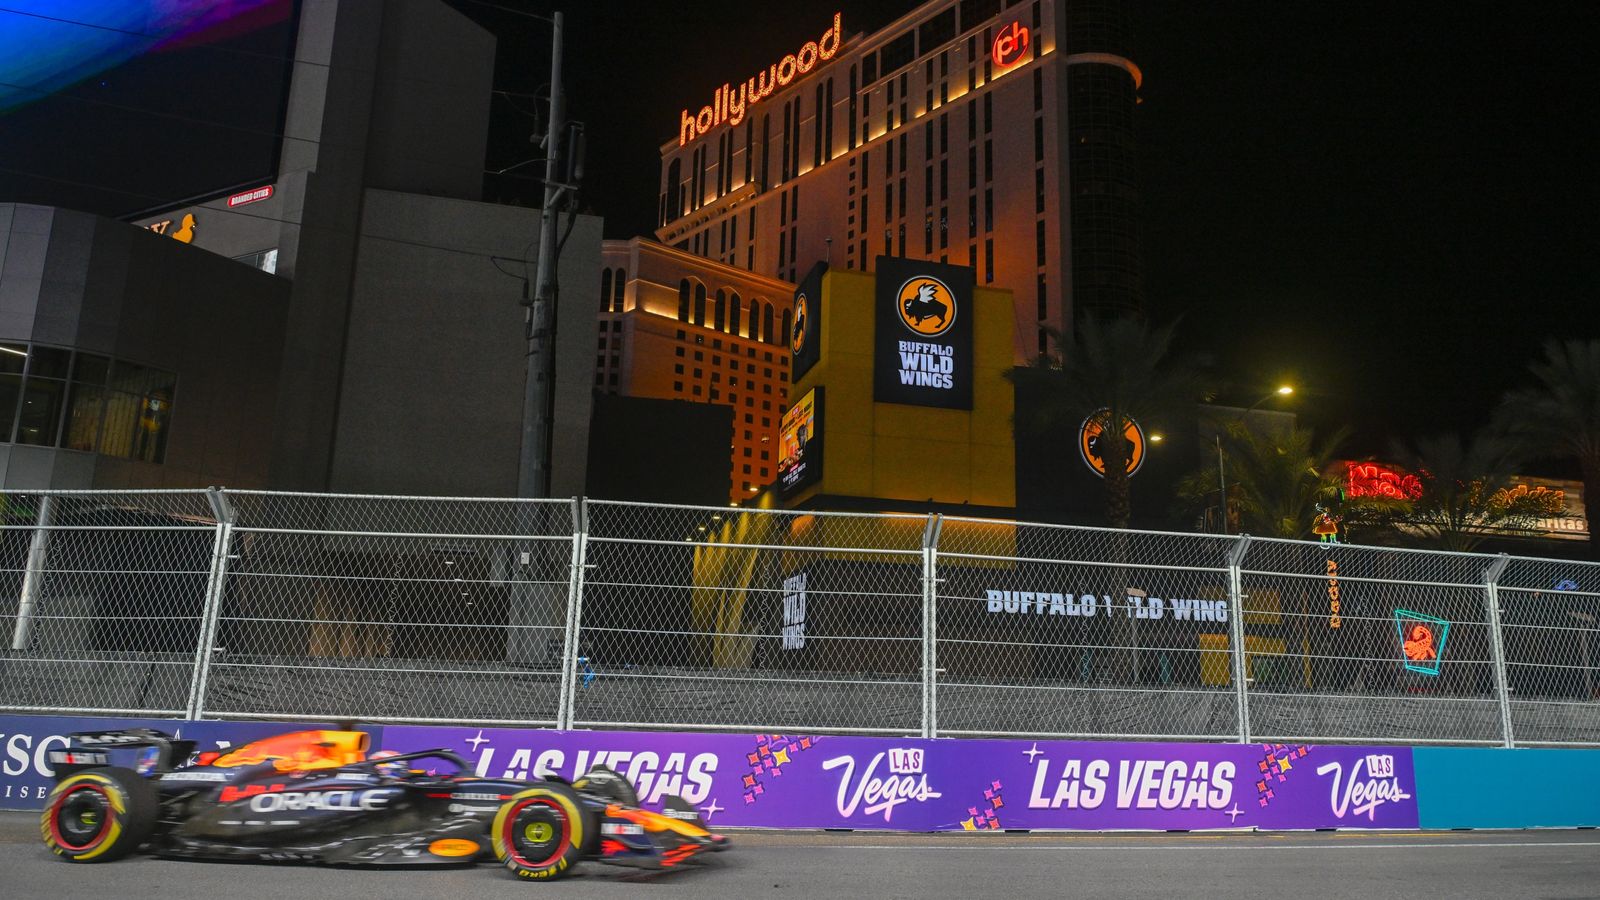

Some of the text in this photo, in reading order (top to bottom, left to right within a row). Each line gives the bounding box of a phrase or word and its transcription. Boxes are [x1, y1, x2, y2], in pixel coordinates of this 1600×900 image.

[997, 21, 1029, 65] ph
[679, 11, 841, 147] hollywood
[898, 341, 953, 357] BUFFALO
[898, 352, 954, 374] WILD
[898, 369, 953, 389] WINGS
[986, 589, 1097, 617] BUFFALO
[1169, 598, 1228, 622] WING
[893, 751, 921, 770] LAS
[1369, 757, 1391, 775] LAS
[822, 752, 942, 822] Vegas
[1028, 759, 1236, 809] LAS VEGAS
[1317, 758, 1411, 821] Vegas
[250, 789, 394, 813] ORACLE
